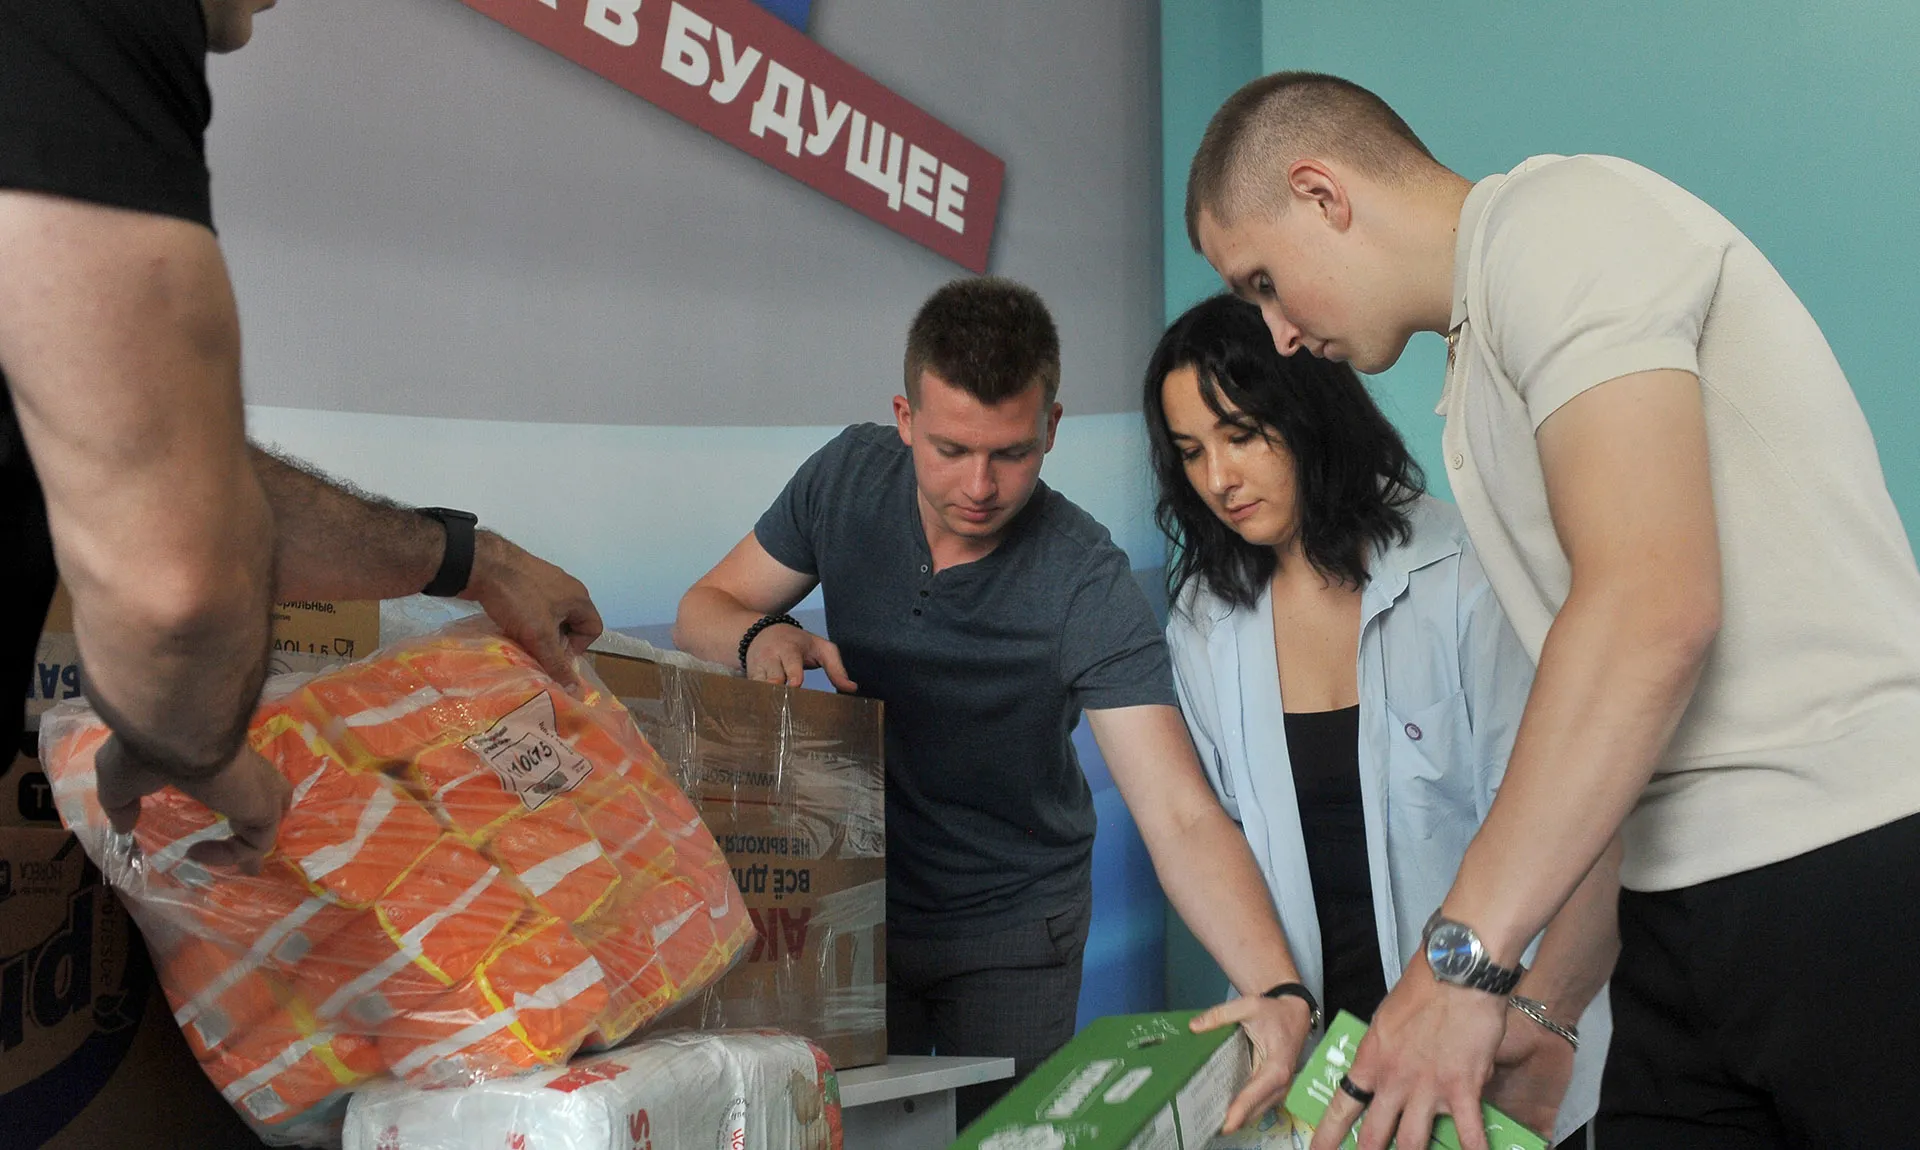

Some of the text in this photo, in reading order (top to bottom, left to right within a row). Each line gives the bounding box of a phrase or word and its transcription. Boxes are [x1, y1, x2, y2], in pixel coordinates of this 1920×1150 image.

[583, 0, 970, 234] В БУДУЩЕЕ
[308, 643, 328, 656] 15
[725, 833, 789, 855] ВЫХОДЯ
[792, 833, 811, 856] НЕ
[773, 868, 811, 900] ВСЁ
